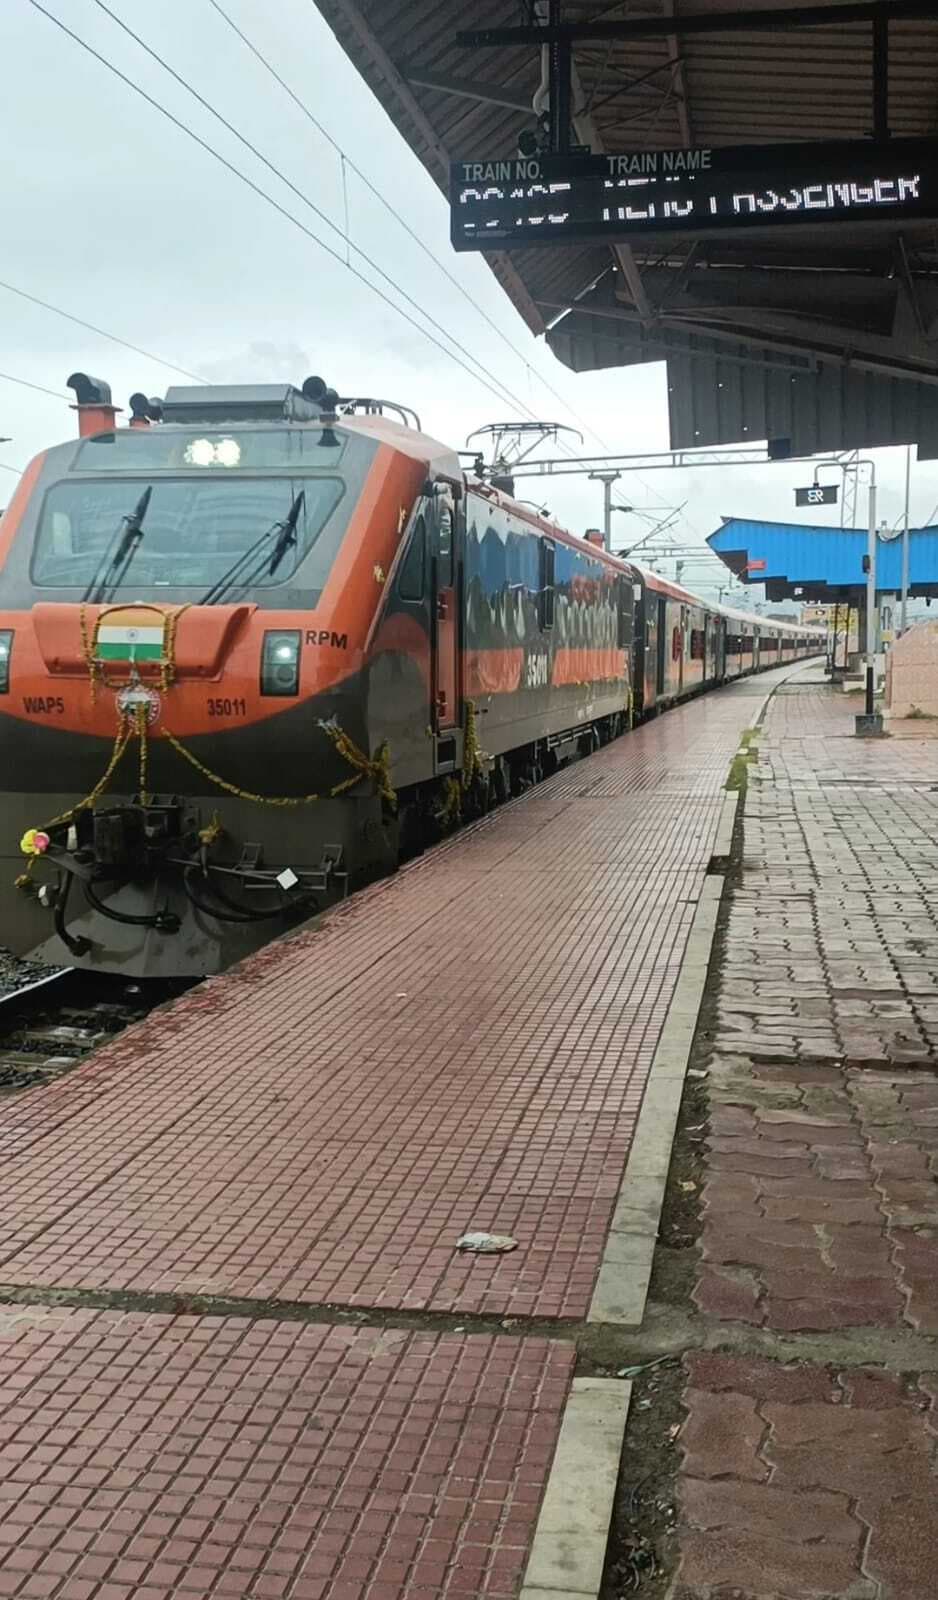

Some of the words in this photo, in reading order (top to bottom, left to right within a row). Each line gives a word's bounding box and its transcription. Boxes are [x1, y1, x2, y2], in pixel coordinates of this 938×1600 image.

[462, 161, 511, 182] TRAIN
[515, 160, 544, 180] NO.
[607, 153, 657, 175] TRAIN
[662, 150, 712, 171] NAME
[305, 630, 348, 650] RPM
[23, 696, 65, 714] WAP5
[207, 698, 247, 716] 35011
